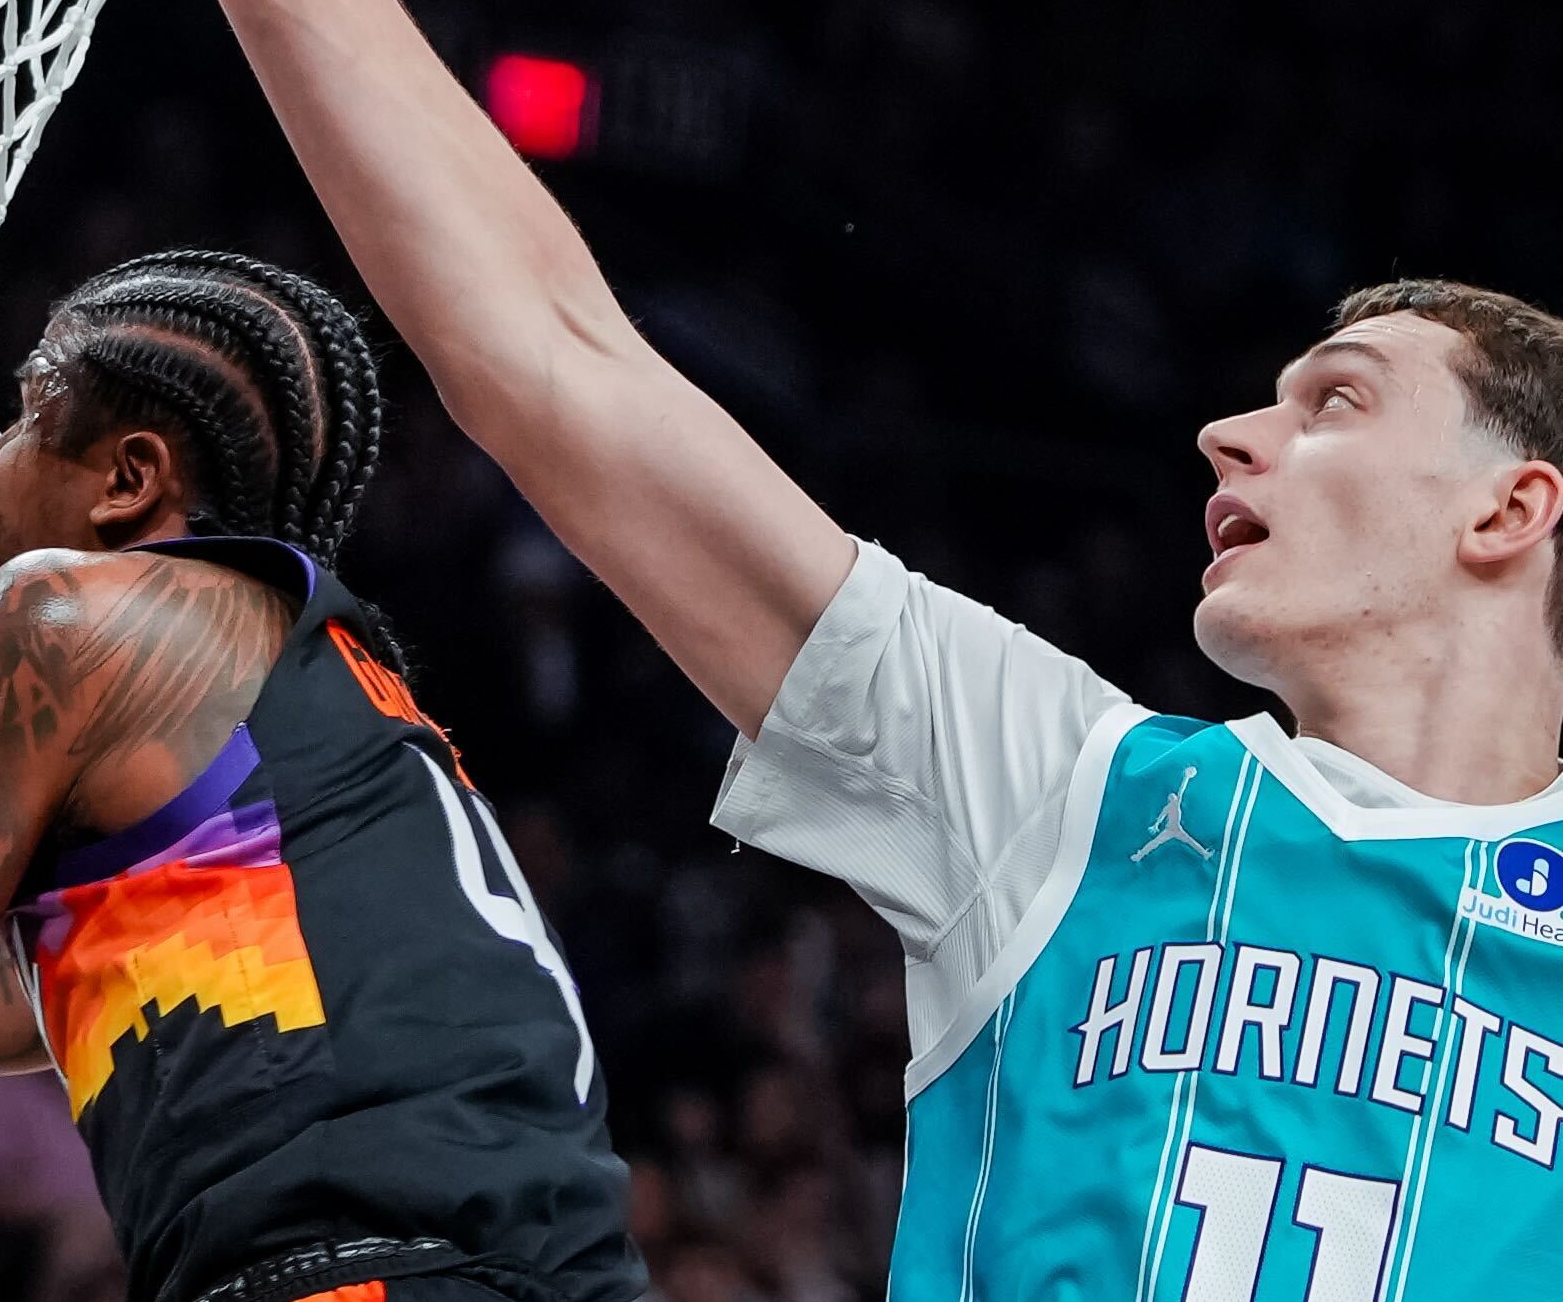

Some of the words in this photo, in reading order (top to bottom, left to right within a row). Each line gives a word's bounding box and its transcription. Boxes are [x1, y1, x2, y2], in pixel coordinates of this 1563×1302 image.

[402, 740, 595, 1106] 4
[1462, 895, 1518, 929] Judi
[1070, 940, 1563, 1171] HORNETS
